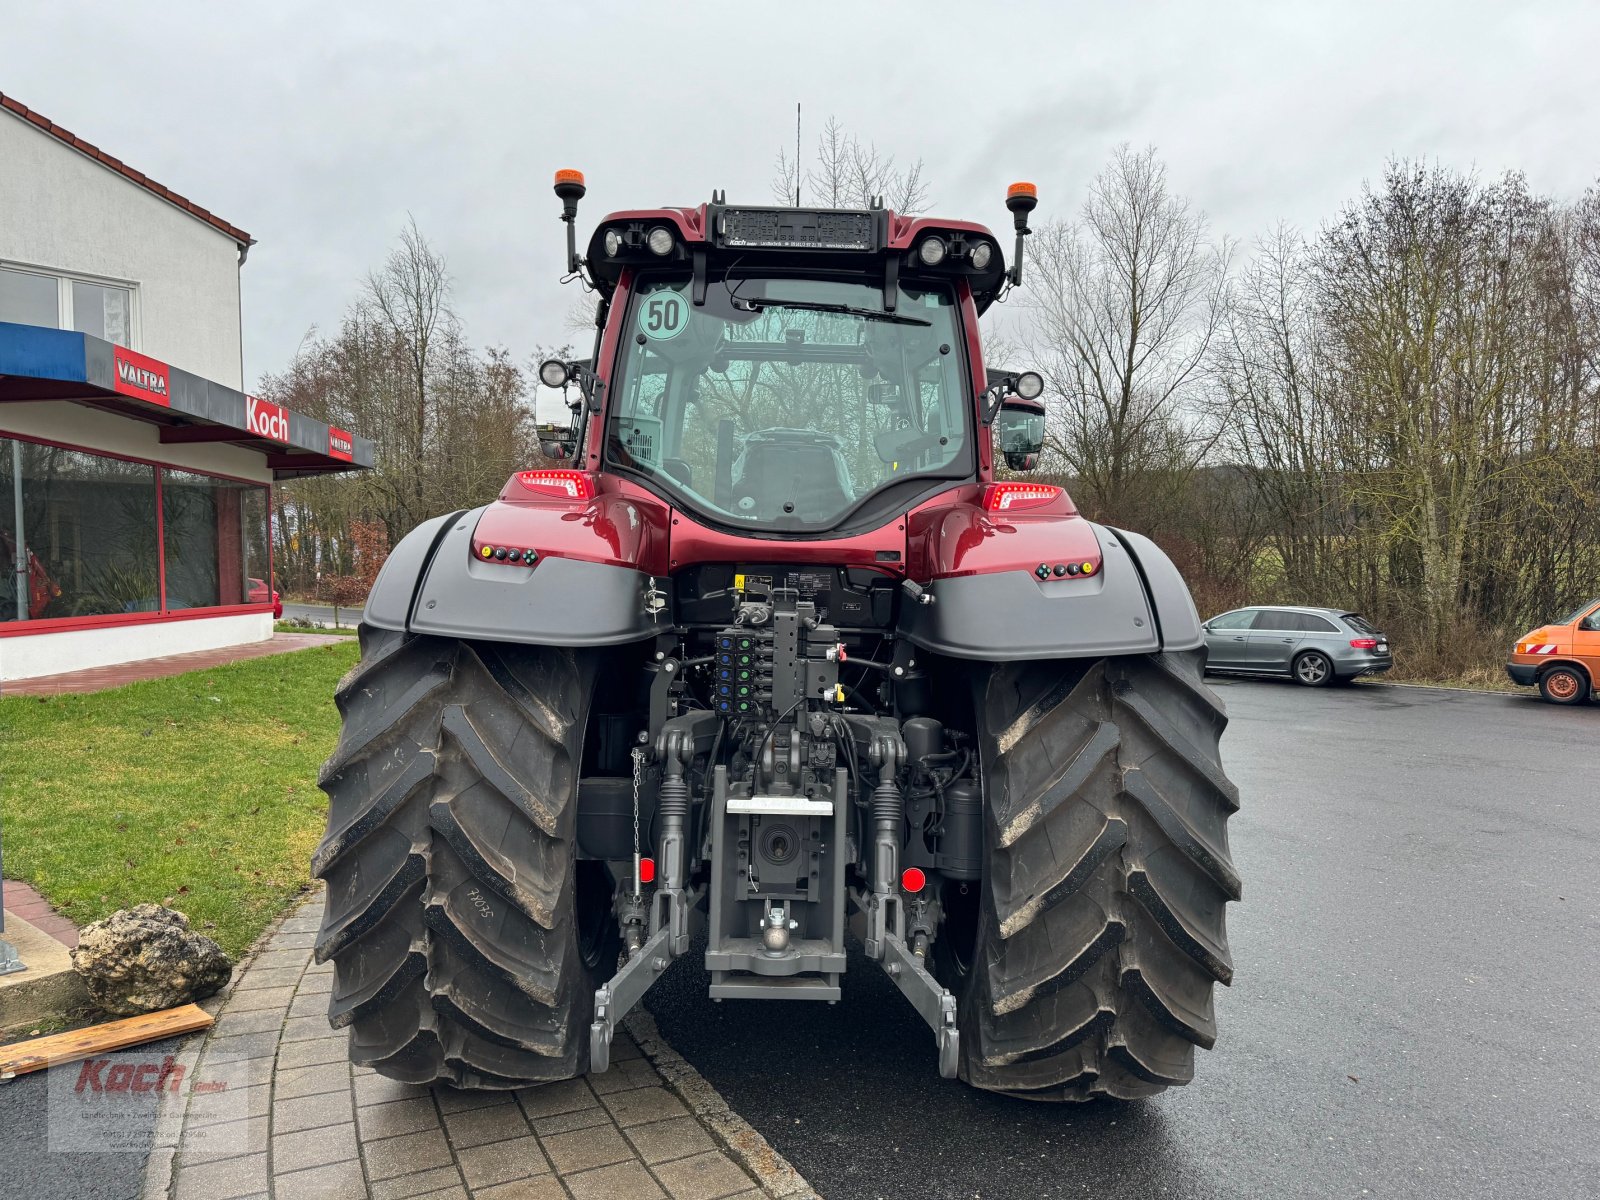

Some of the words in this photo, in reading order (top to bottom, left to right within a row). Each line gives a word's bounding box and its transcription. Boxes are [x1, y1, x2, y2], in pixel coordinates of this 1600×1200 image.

[648, 299, 679, 331] 50
[117, 357, 167, 395] VALTRA
[246, 396, 288, 441] Koch
[330, 435, 352, 455] VALTRA
